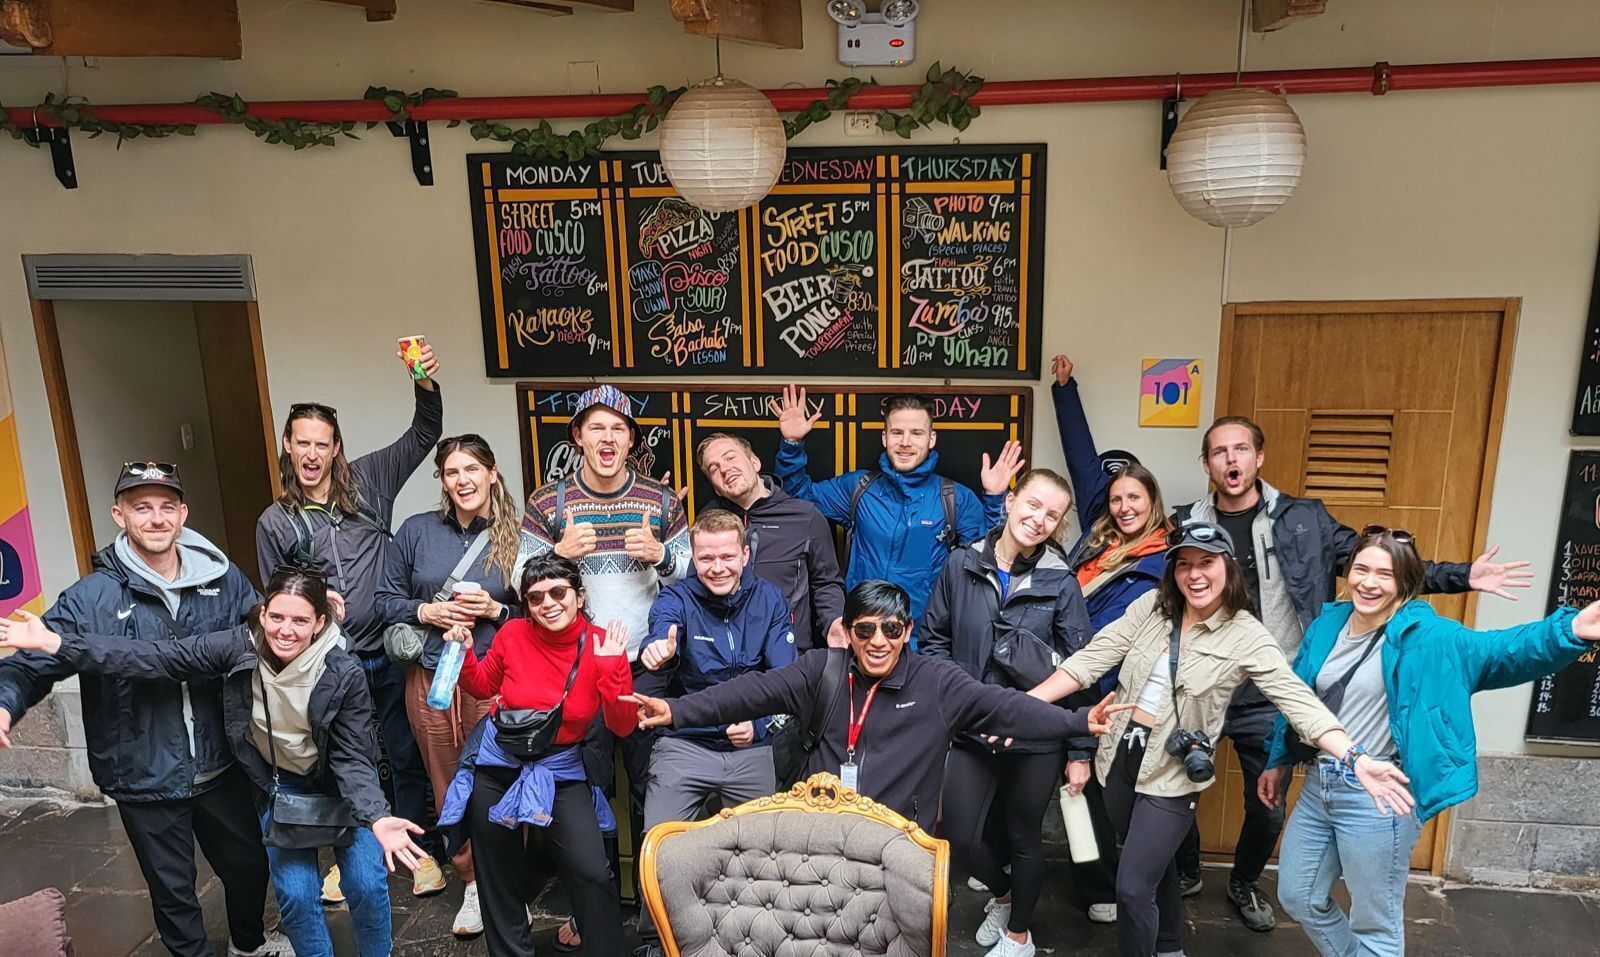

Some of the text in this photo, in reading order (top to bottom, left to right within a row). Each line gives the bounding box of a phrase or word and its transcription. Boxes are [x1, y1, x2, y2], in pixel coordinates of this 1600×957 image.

[506, 165, 591, 186] MONDAY
[777, 158, 874, 183] EDNESDAY
[901, 155, 1018, 181] THURSDAY
[934, 195, 984, 214] PHOTO
[658, 220, 712, 254] PIZZA
[763, 202, 836, 247] STREET
[500, 219, 585, 258] FOOD CUSCO
[688, 241, 713, 260] NIGHT
[761, 229, 874, 277] FOOD CUSCO
[519, 255, 597, 290] Tattoo
[631, 263, 661, 286] MAKE
[901, 257, 986, 290] TATTOO
[643, 297, 667, 314] OWN
[686, 286, 721, 309] SOUR
[763, 275, 835, 322] BEER
[779, 299, 841, 358] PONG
[908, 295, 989, 337] Zumba
[673, 320, 728, 366] Bachata
[916, 332, 937, 347] DJ
[692, 350, 727, 364] LESSON
[1191, 365, 1200, 375] A
[704, 394, 824, 418] SATURY
[1155, 382, 1189, 405] 101
